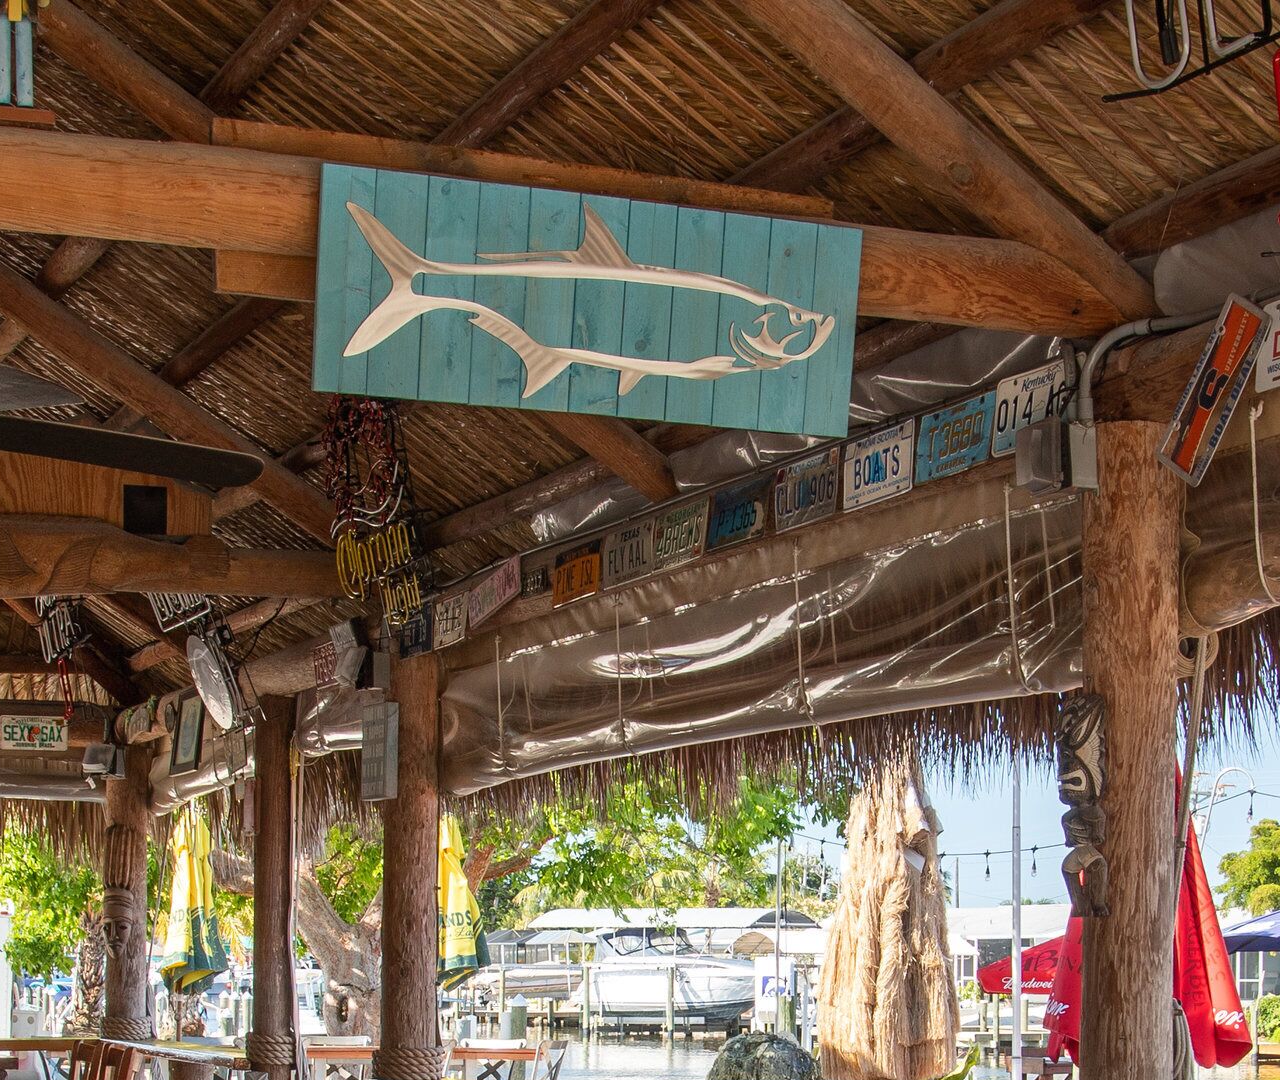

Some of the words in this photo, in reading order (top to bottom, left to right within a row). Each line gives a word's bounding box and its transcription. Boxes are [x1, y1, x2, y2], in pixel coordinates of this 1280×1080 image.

[1225, 311, 1250, 371] UNIVERSITY
[1021, 371, 1056, 392] Kentucky
[997, 391, 1034, 433] 014
[1209, 403, 1233, 450] BOAT
[854, 444, 901, 491] BOATS
[810, 470, 835, 505] 906
[621, 527, 641, 541] TEXAS
[608, 548, 626, 576] FLY
[628, 540, 647, 569] AAL
[3, 724, 33, 742] SEXY
[40, 726, 64, 743] SAX
